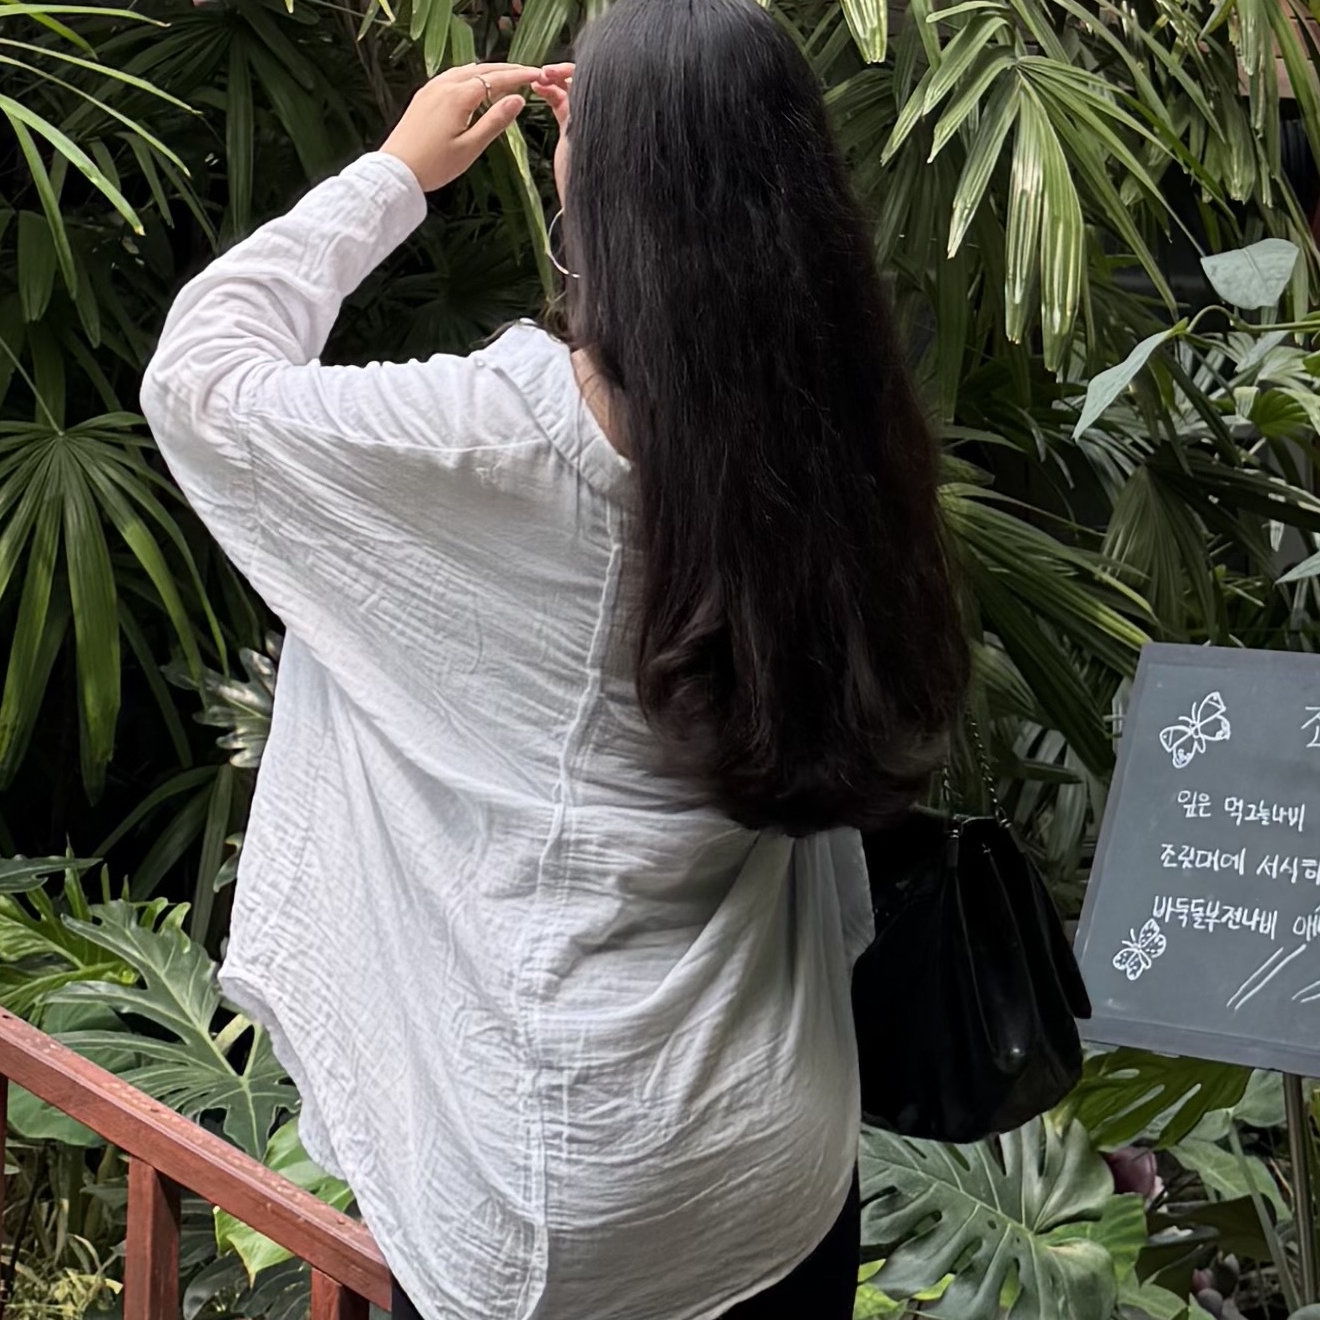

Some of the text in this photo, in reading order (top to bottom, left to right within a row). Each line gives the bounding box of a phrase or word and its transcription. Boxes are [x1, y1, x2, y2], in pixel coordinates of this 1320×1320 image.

[1177, 790, 1212, 818] 잎은
[1224, 796, 1306, 832] 먹그늘나비
[1160, 842, 1247, 876] 조릿대에
[1152, 895, 1279, 941] 바둑돌부전나비
